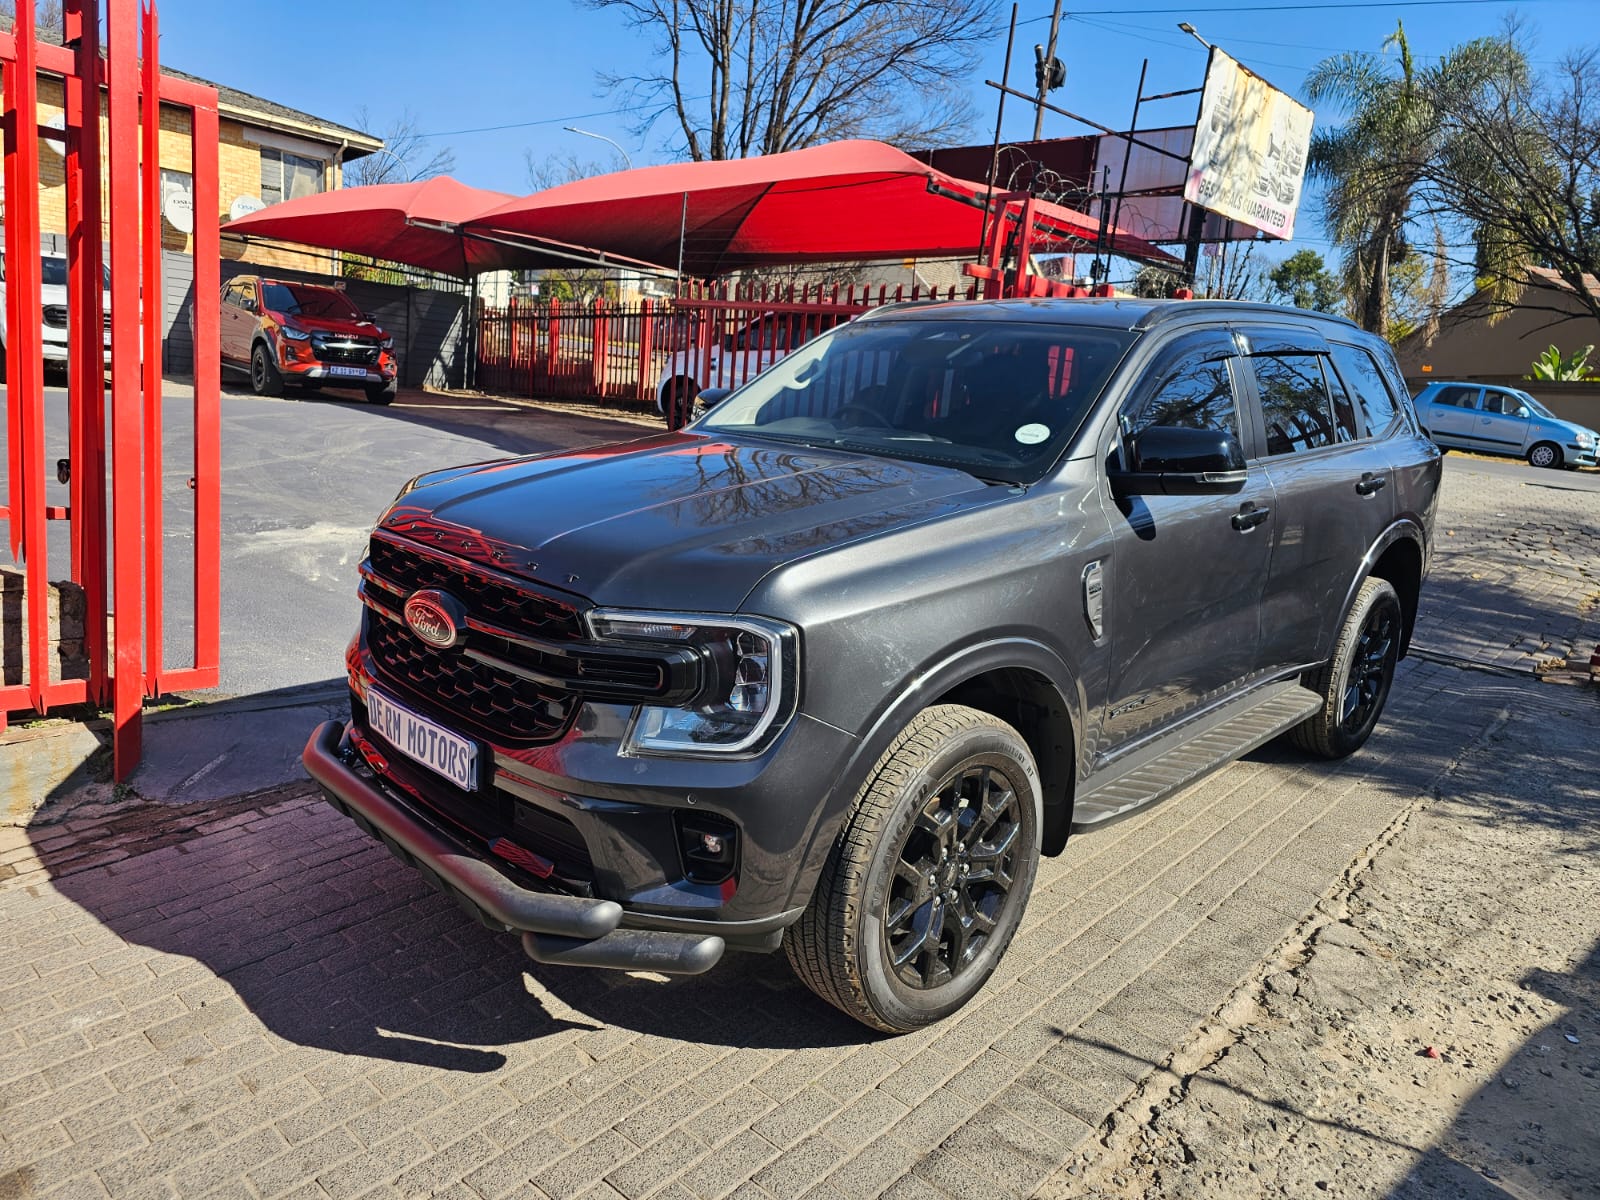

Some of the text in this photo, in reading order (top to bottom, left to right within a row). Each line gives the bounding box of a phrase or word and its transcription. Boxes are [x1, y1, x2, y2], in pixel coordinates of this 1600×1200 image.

[1242, 198, 1286, 229] GUARANTEED
[413, 607, 441, 637] Ford
[407, 718, 467, 782] MOTORS
